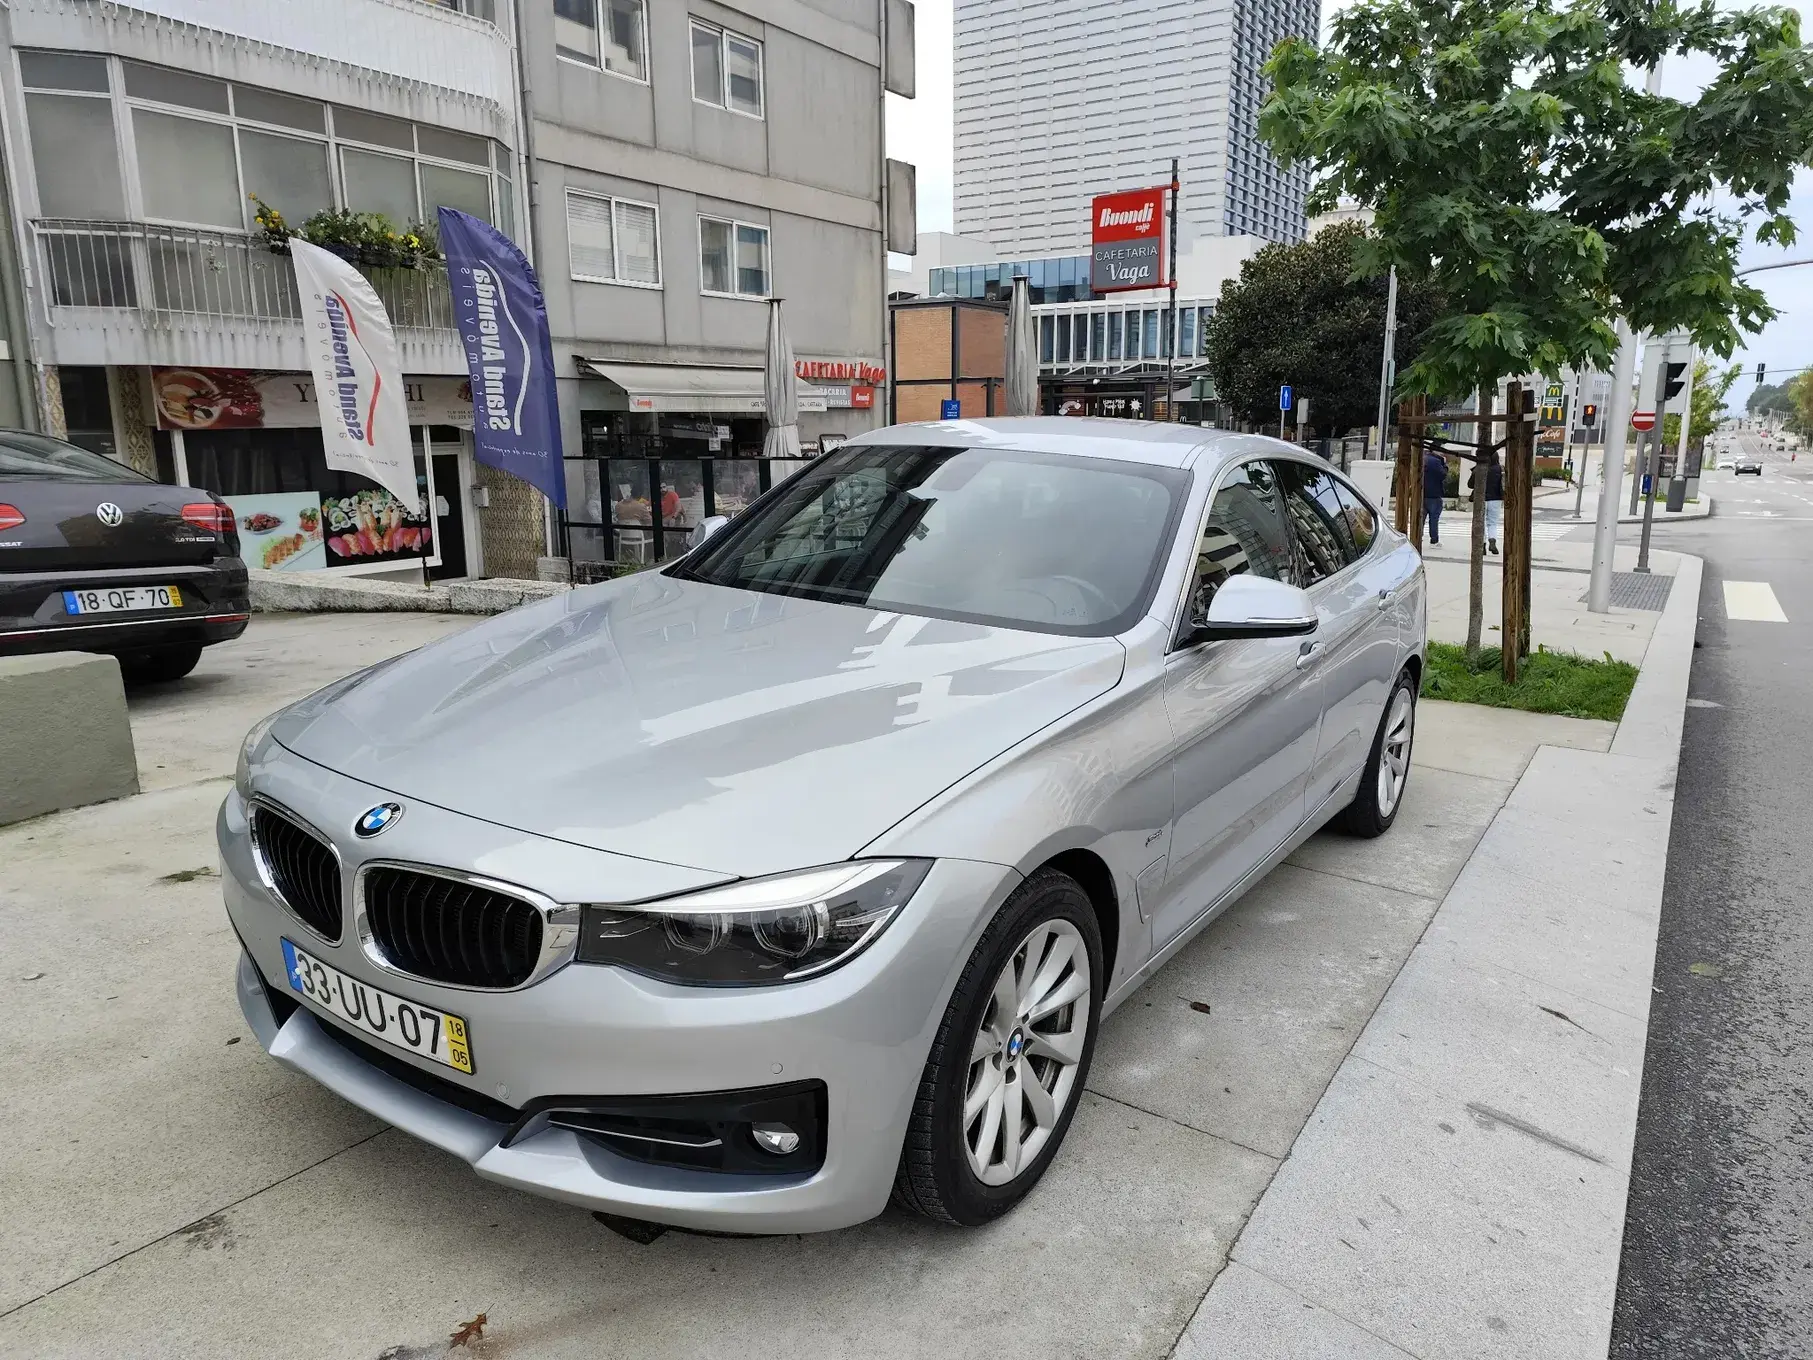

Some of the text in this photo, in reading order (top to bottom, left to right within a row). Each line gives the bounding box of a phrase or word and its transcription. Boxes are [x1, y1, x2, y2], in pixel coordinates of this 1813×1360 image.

[1099, 202, 1155, 228] Buondi
[1095, 246, 1158, 261] CAFETARIA
[1106, 262, 1151, 284] Vaga
[794, 360, 856, 378] CAFETARIA
[449, 1020, 463, 1038] 18
[452, 1048, 468, 1066] 05
